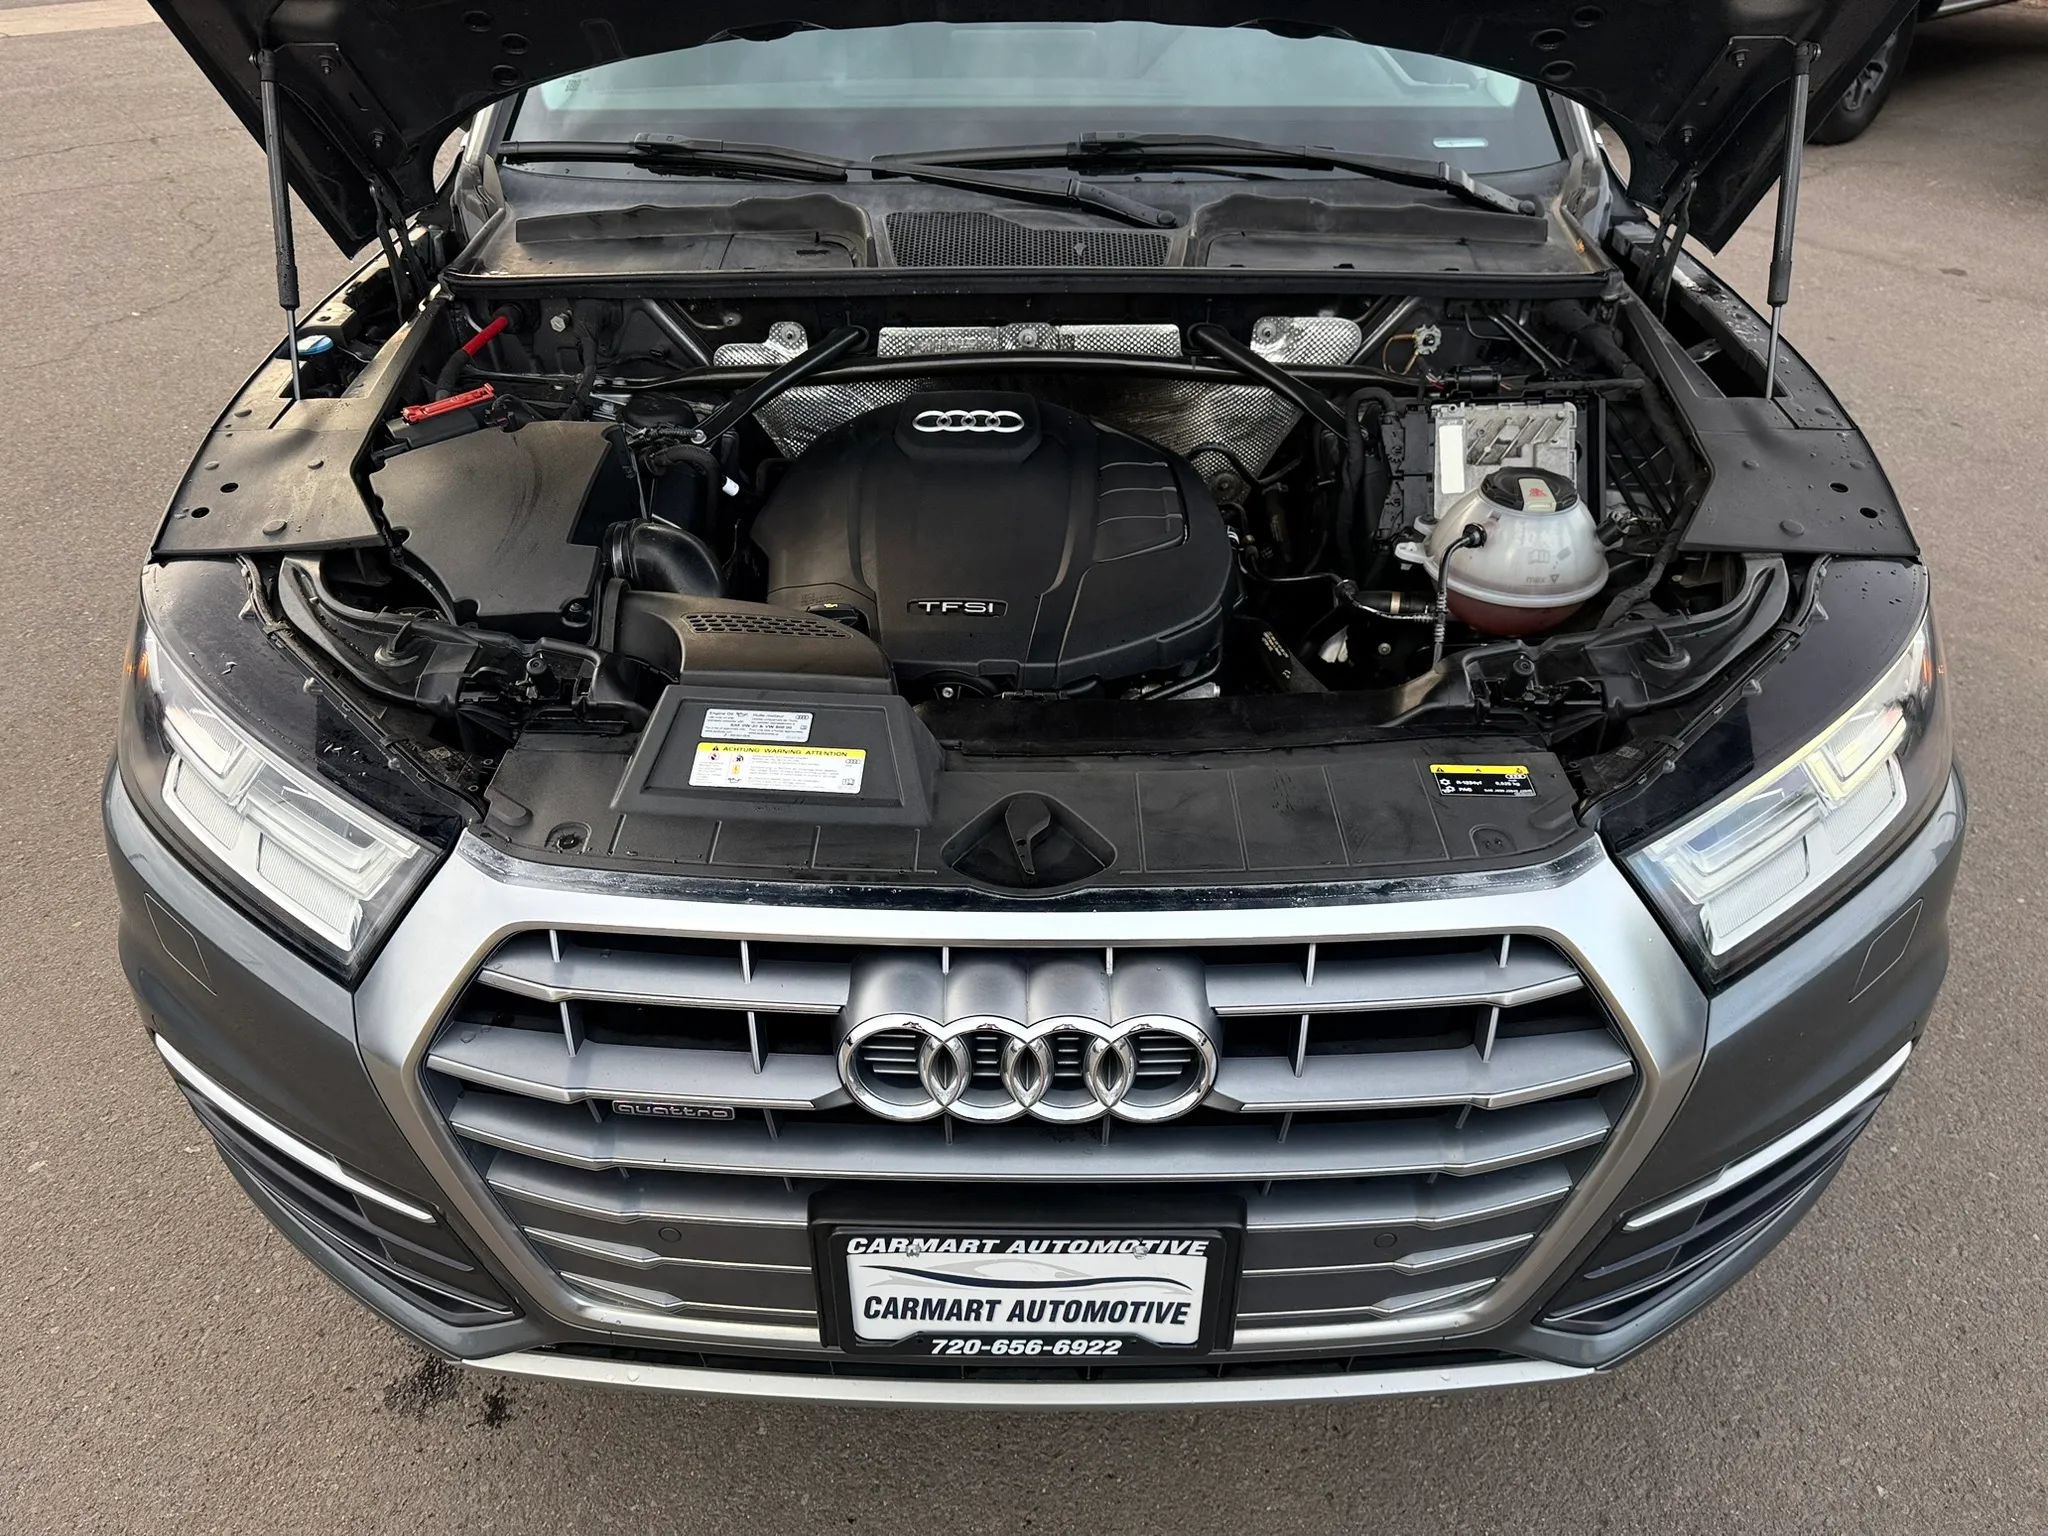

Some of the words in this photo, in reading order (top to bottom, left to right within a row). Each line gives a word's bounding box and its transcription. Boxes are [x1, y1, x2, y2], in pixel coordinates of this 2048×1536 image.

[918, 601, 994, 613] TFSI
[618, 1104, 728, 1118] quattro
[846, 1237, 1001, 1254] CARMART
[1005, 1239, 1210, 1256] AUTOMOTIVE
[863, 1295, 1002, 1322] CARMART
[1007, 1300, 1192, 1326] AUTOMOTIVE
[930, 1339, 1123, 1356] 720-656-6922
